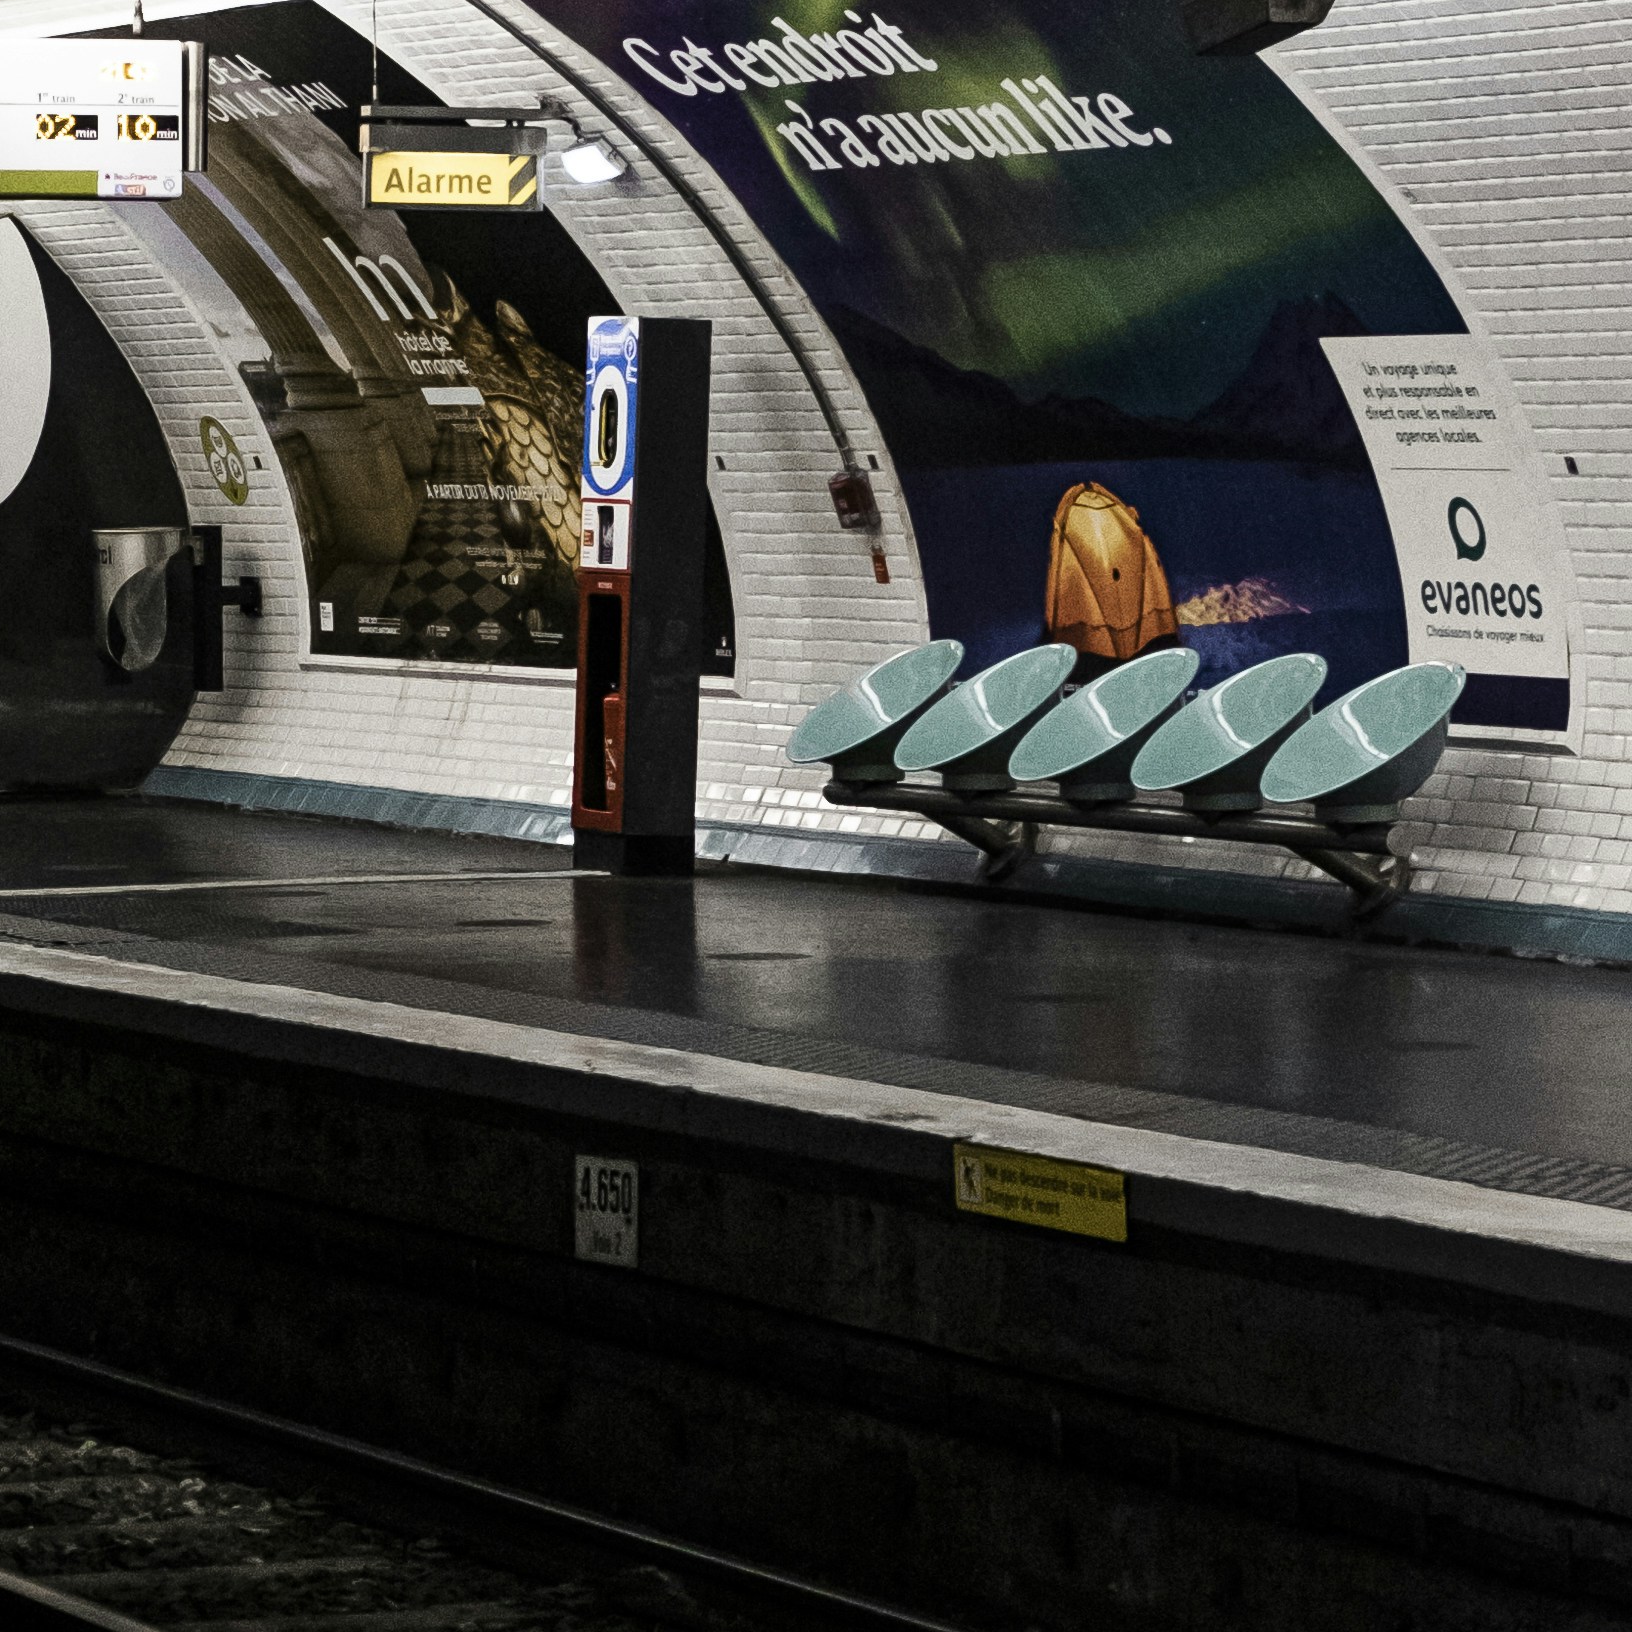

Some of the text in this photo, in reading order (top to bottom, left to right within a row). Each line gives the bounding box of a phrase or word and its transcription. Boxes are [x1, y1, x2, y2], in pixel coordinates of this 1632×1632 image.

[622, 9, 938, 97] Cet endroit
[52, 94, 76, 103] train
[131, 95, 155, 104] train
[258, 81, 348, 114] THANI
[35, 113, 98, 141] 02 min
[117, 113, 178, 141] 10 min
[776, 74, 1173, 171] n'a aucun like.
[384, 166, 493, 195] Alarme
[1362, 361, 1458, 380] Un voyage unique
[1363, 382, 1481, 400] et plus responsable en
[1365, 405, 1497, 420] direct avec les meilleures
[1396, 430, 1441, 447] agences
[1421, 579, 1543, 619] evaneos
[1473, 627, 1484, 640] de
[1484, 630, 1517, 644] voyager
